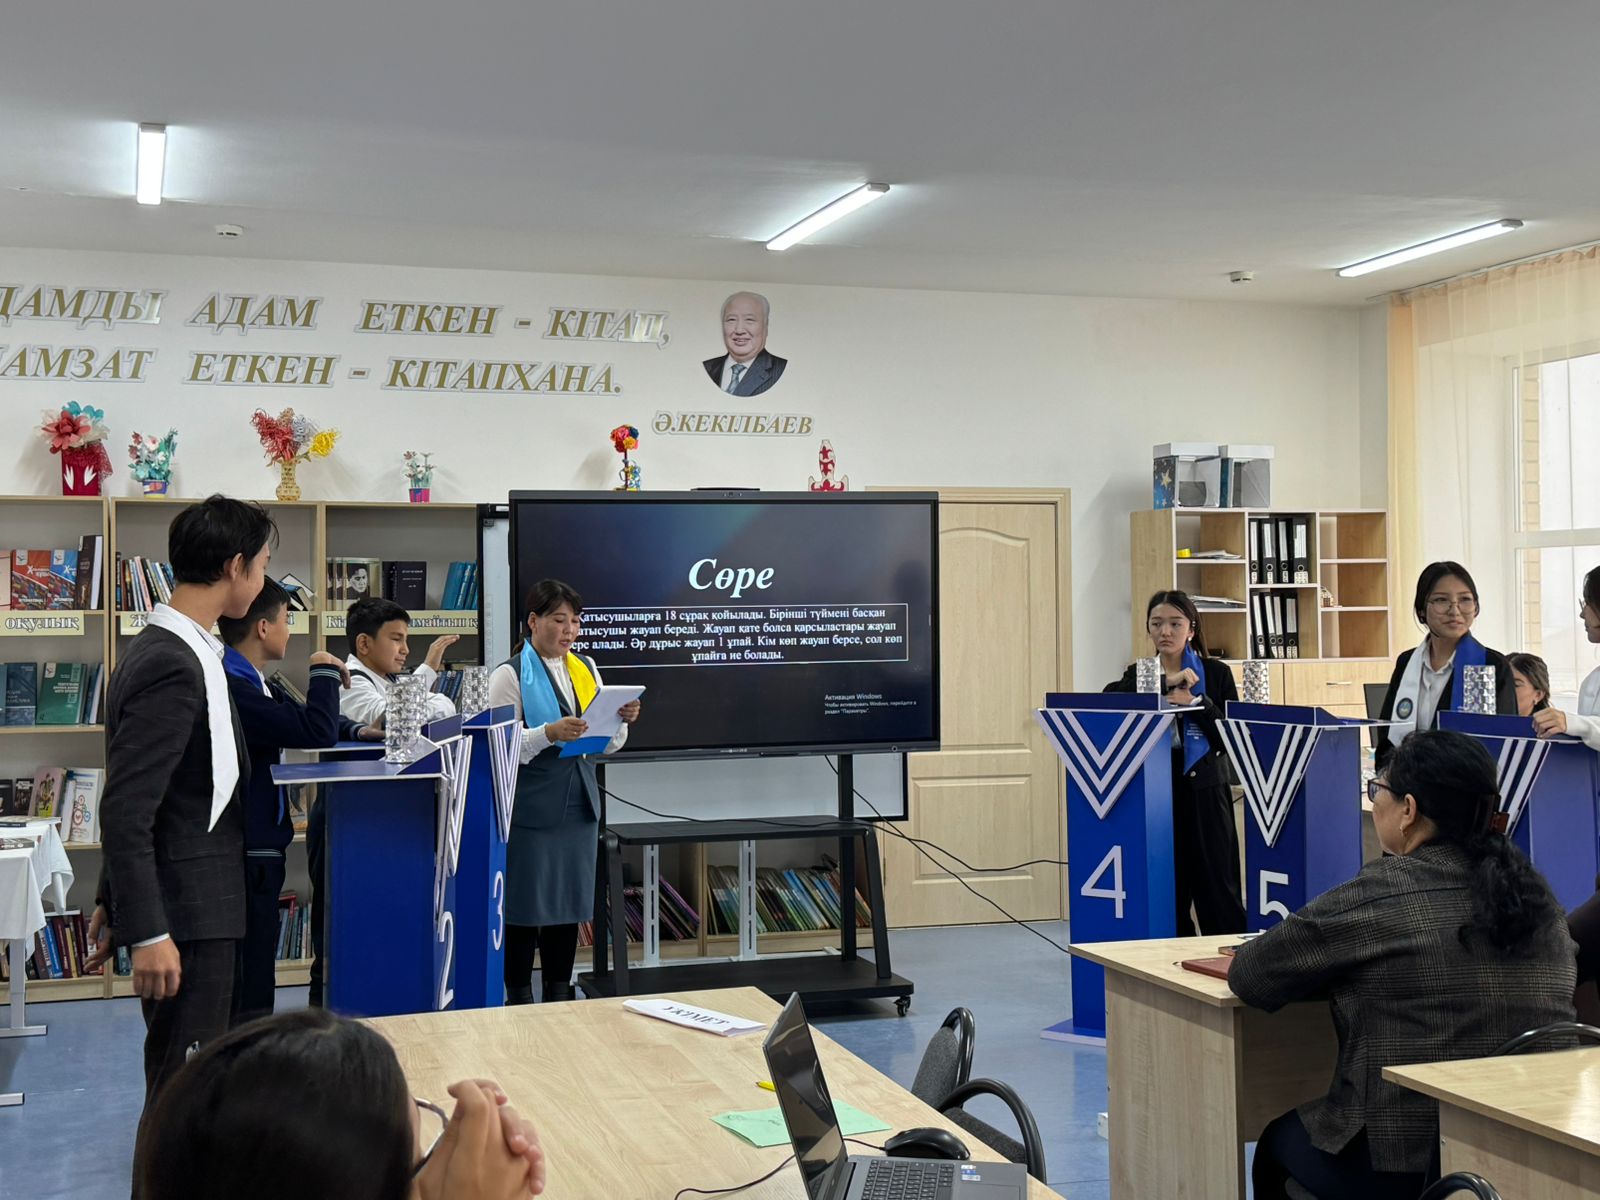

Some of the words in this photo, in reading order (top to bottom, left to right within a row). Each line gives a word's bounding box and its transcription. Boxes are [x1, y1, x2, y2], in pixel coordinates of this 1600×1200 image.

[190, 295, 320, 332] АДАМ
[358, 301, 500, 335] ЕТКЕН
[518, 319, 532, 327] -
[547, 308, 670, 346] КІТАП,
[0, 347, 155, 380] АМЗАТ
[186, 352, 337, 386] ЕТКЕН
[352, 369, 366, 377] -
[385, 359, 622, 394] КІТАПХАНА.
[654, 412, 813, 435] Ә.КЕКІЛБАЕВ
[688, 558, 775, 599] Сөре
[5, 617, 80, 633] оқулық
[578, 627, 627, 638] атысушы
[630, 626, 662, 637] жауап
[664, 624, 700, 637] береді.
[702, 623, 736, 636] Жауап
[763, 622, 792, 633] болса
[867, 622, 897, 633] жауап
[665, 610, 677, 621] 18
[711, 609, 767, 622] қойылады.
[769, 608, 808, 622] Бірінші
[809, 608, 850, 620] түймені
[571, 641, 590, 652] ере
[592, 640, 628, 650] алады.
[630, 637, 647, 651] Әр
[684, 638, 715, 650] жауап
[719, 637, 723, 647] 1
[757, 635, 776, 646] Кім
[779, 637, 797, 646] көп
[800, 637, 830, 647] жауап
[865, 635, 882, 644] сол
[885, 635, 903, 644] көп
[743, 649, 785, 660] болады.
[1080, 845, 1127, 919] 4
[1259, 869, 1290, 934] 5
[492, 870, 504, 951] 3
[438, 911, 455, 1011] 2
